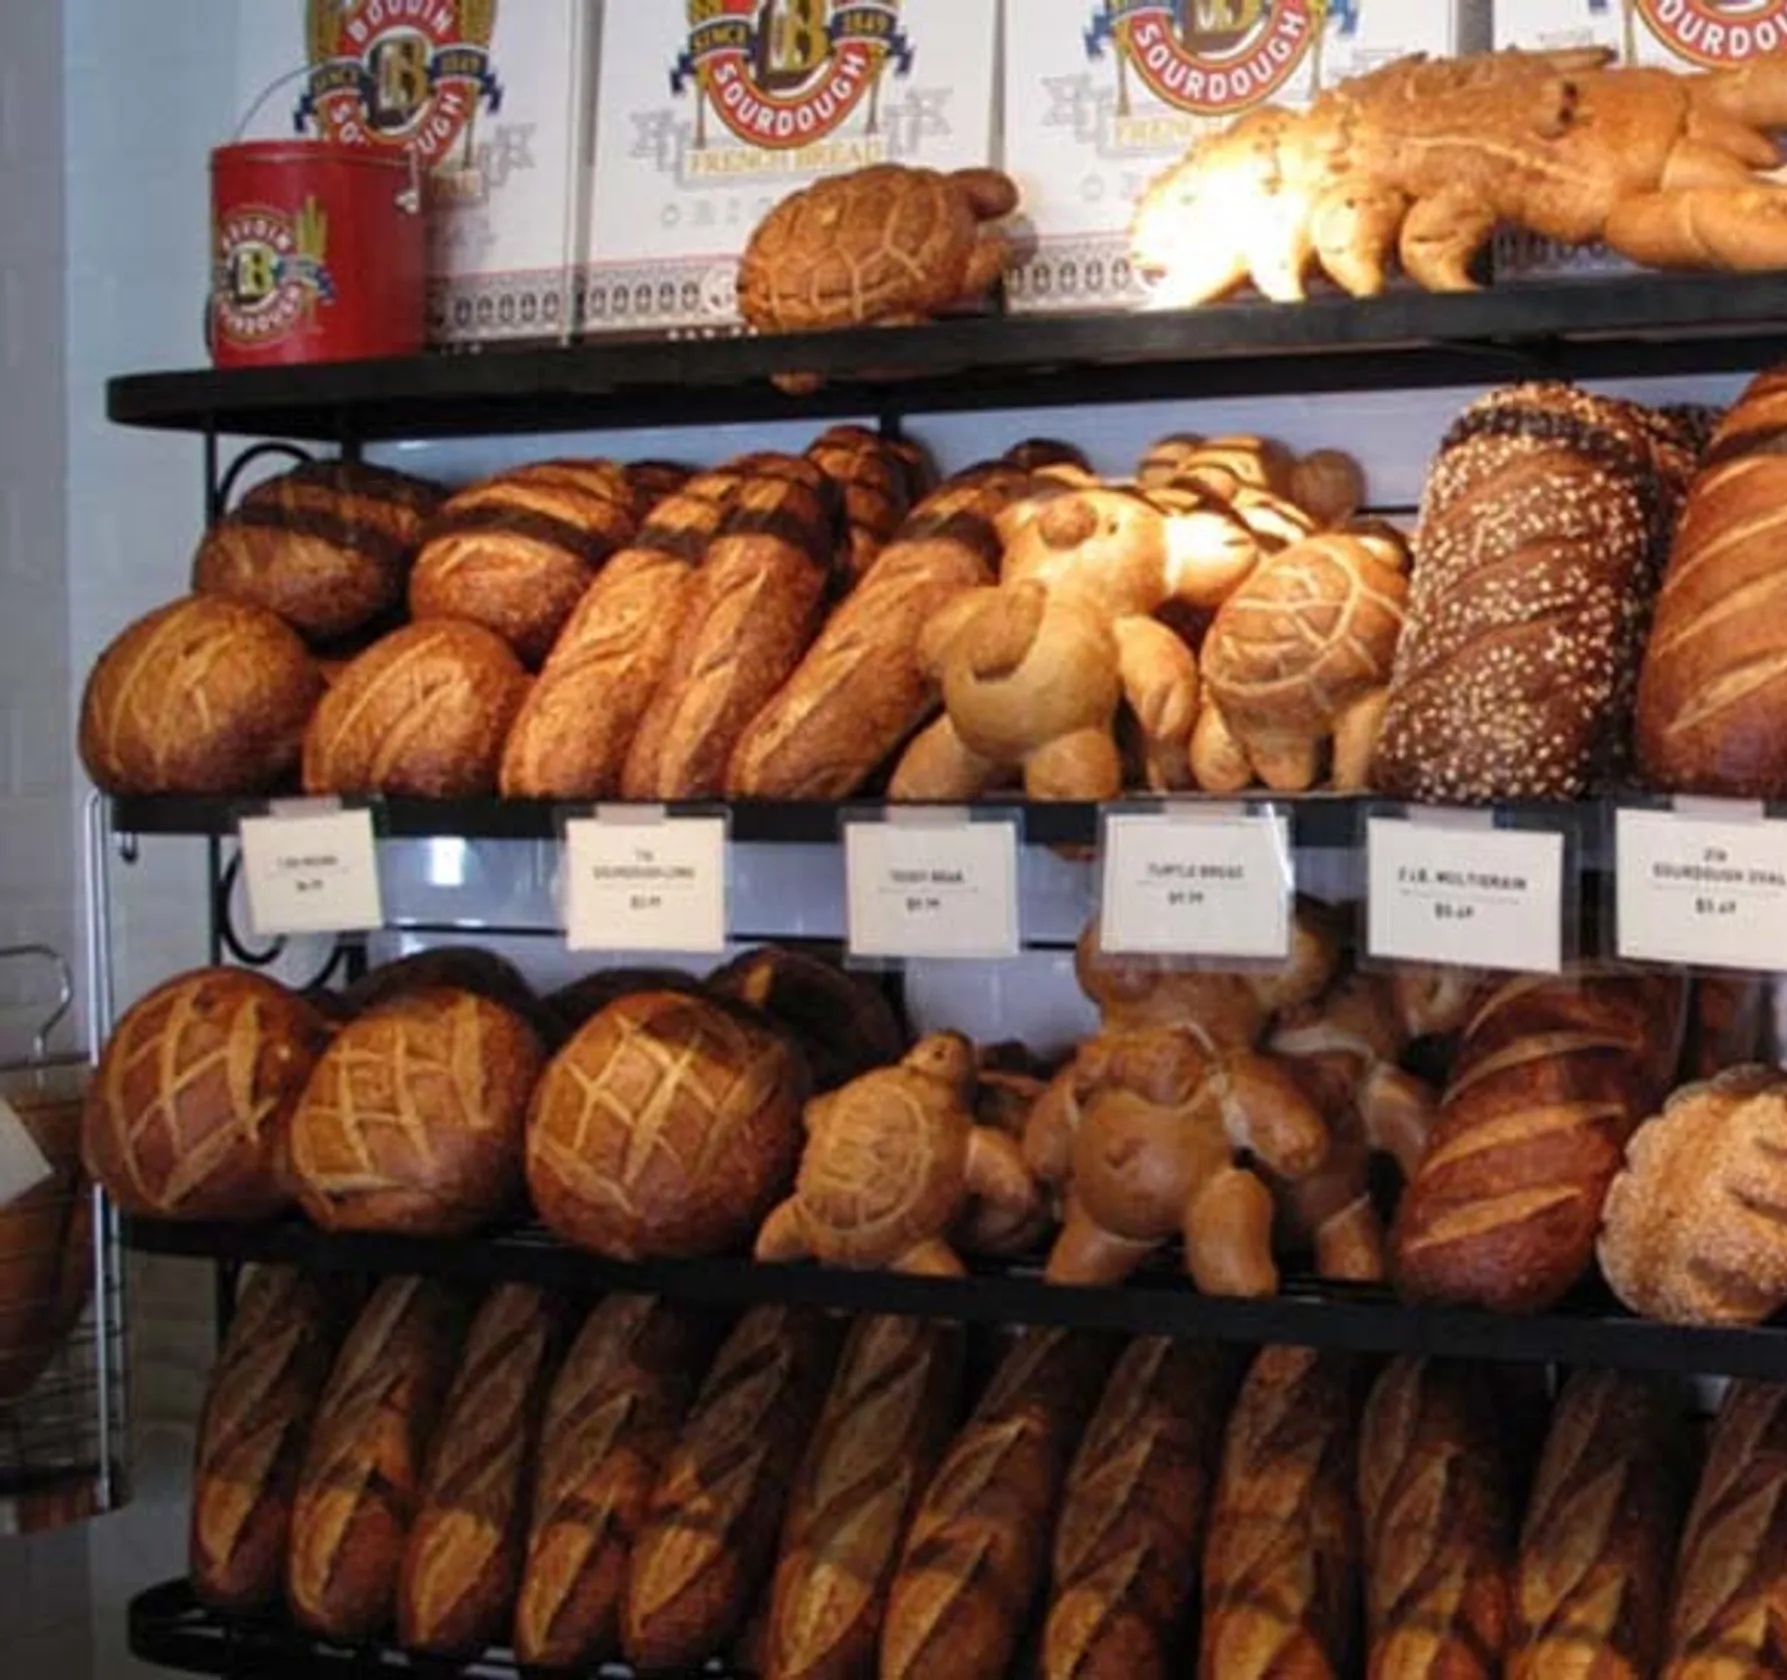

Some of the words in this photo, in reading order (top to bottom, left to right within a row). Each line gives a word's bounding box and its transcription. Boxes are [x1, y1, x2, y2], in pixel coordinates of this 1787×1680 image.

[1134, 8, 1307, 101] SOURDOUGH
[331, 92, 463, 154] SOUGH
[713, 53, 867, 137] SOURDOUGH
[1434, 870, 1528, 891] MULTIGRAIN
